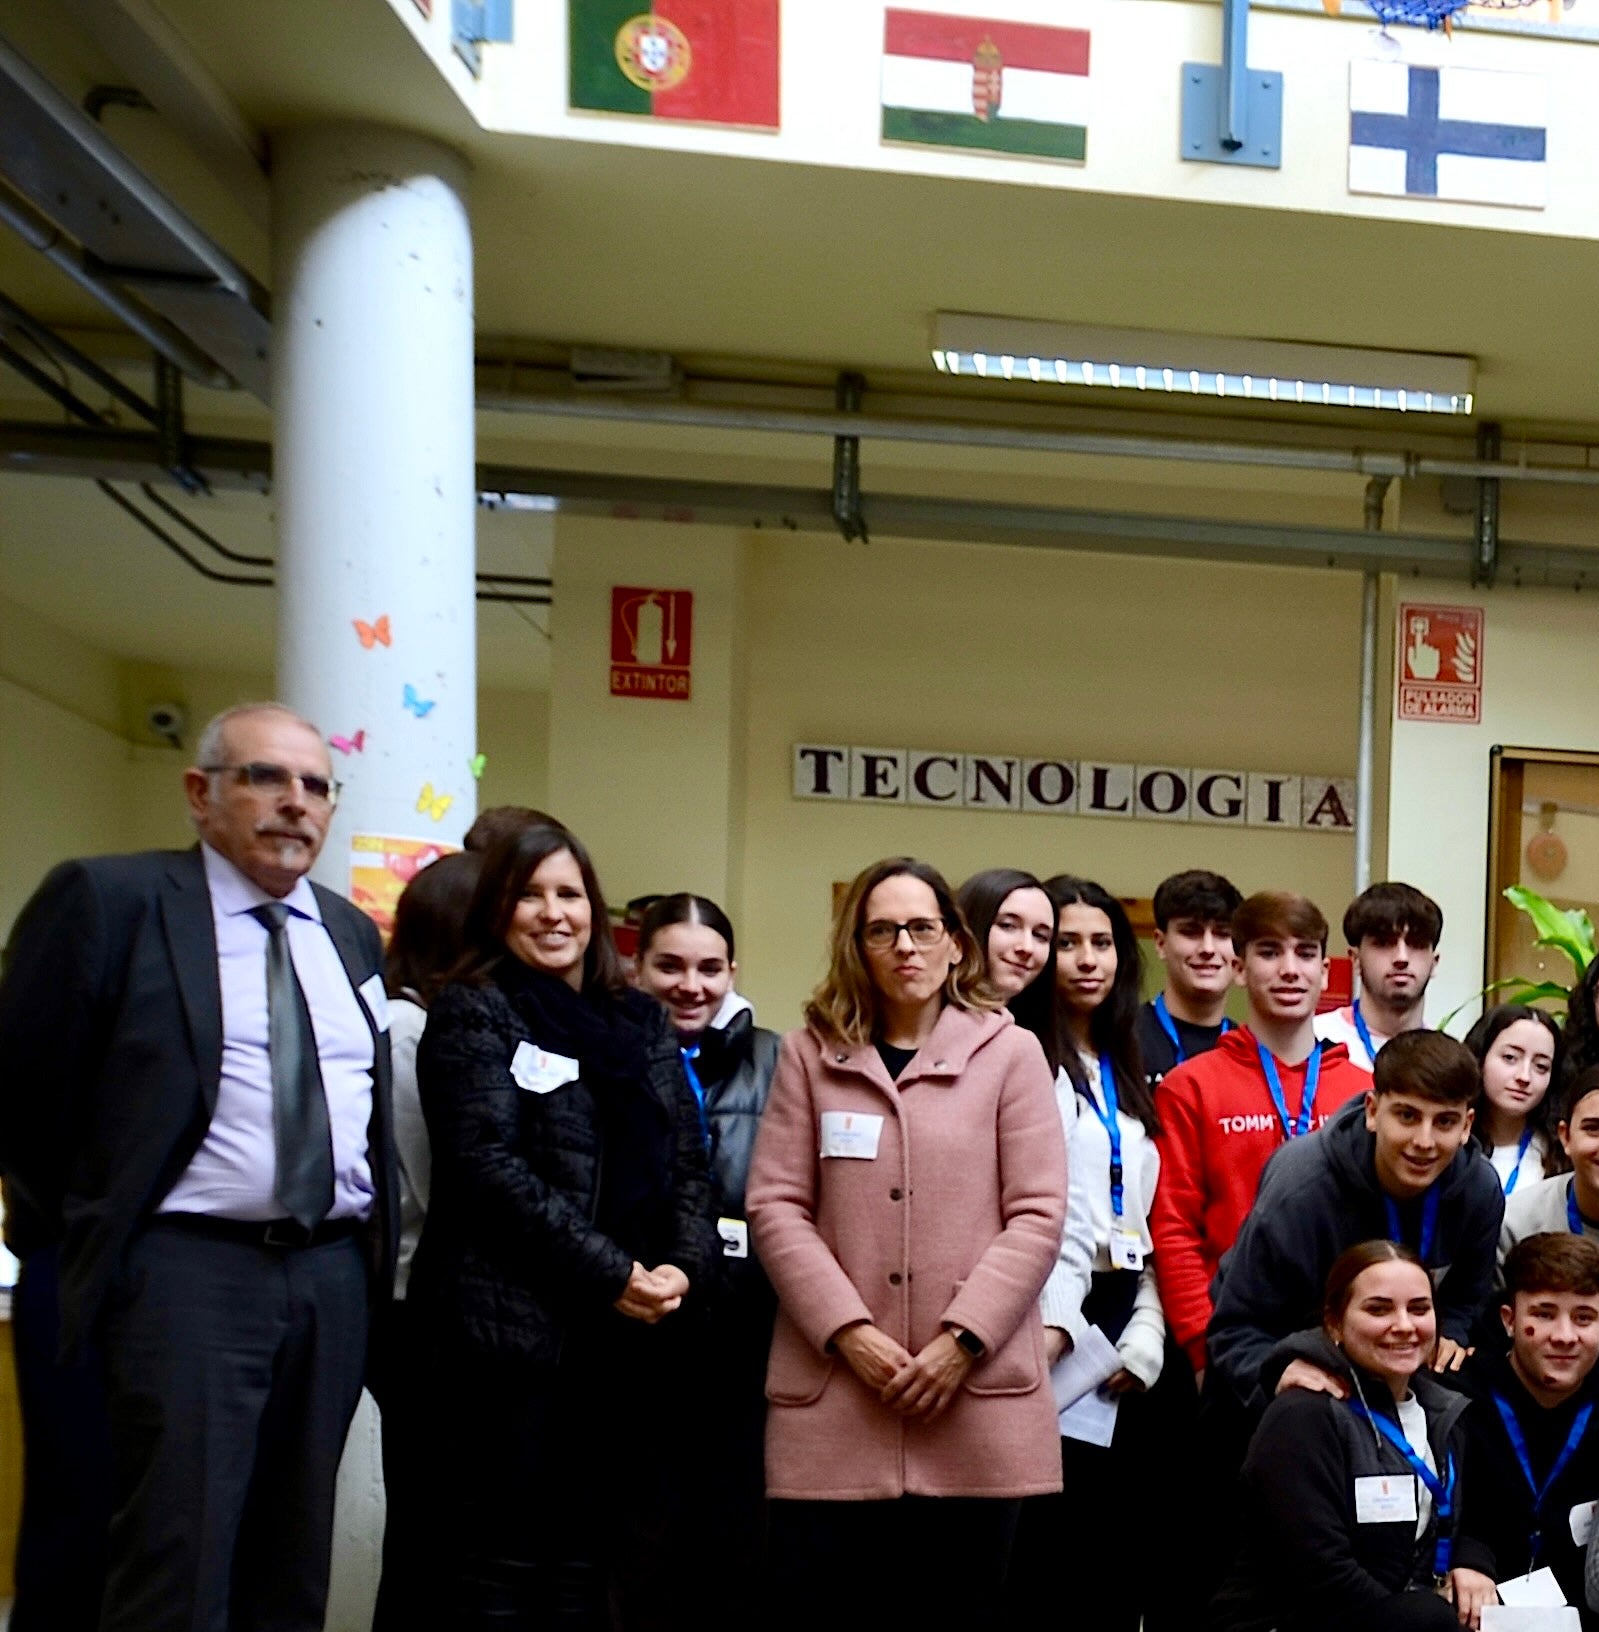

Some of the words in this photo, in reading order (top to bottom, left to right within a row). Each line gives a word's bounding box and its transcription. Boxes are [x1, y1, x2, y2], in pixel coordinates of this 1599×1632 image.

[612, 670, 688, 693] EXTINTOR
[800, 748, 1353, 827] TECNOLOGIA
[1218, 1114, 1277, 1135] TOMM
